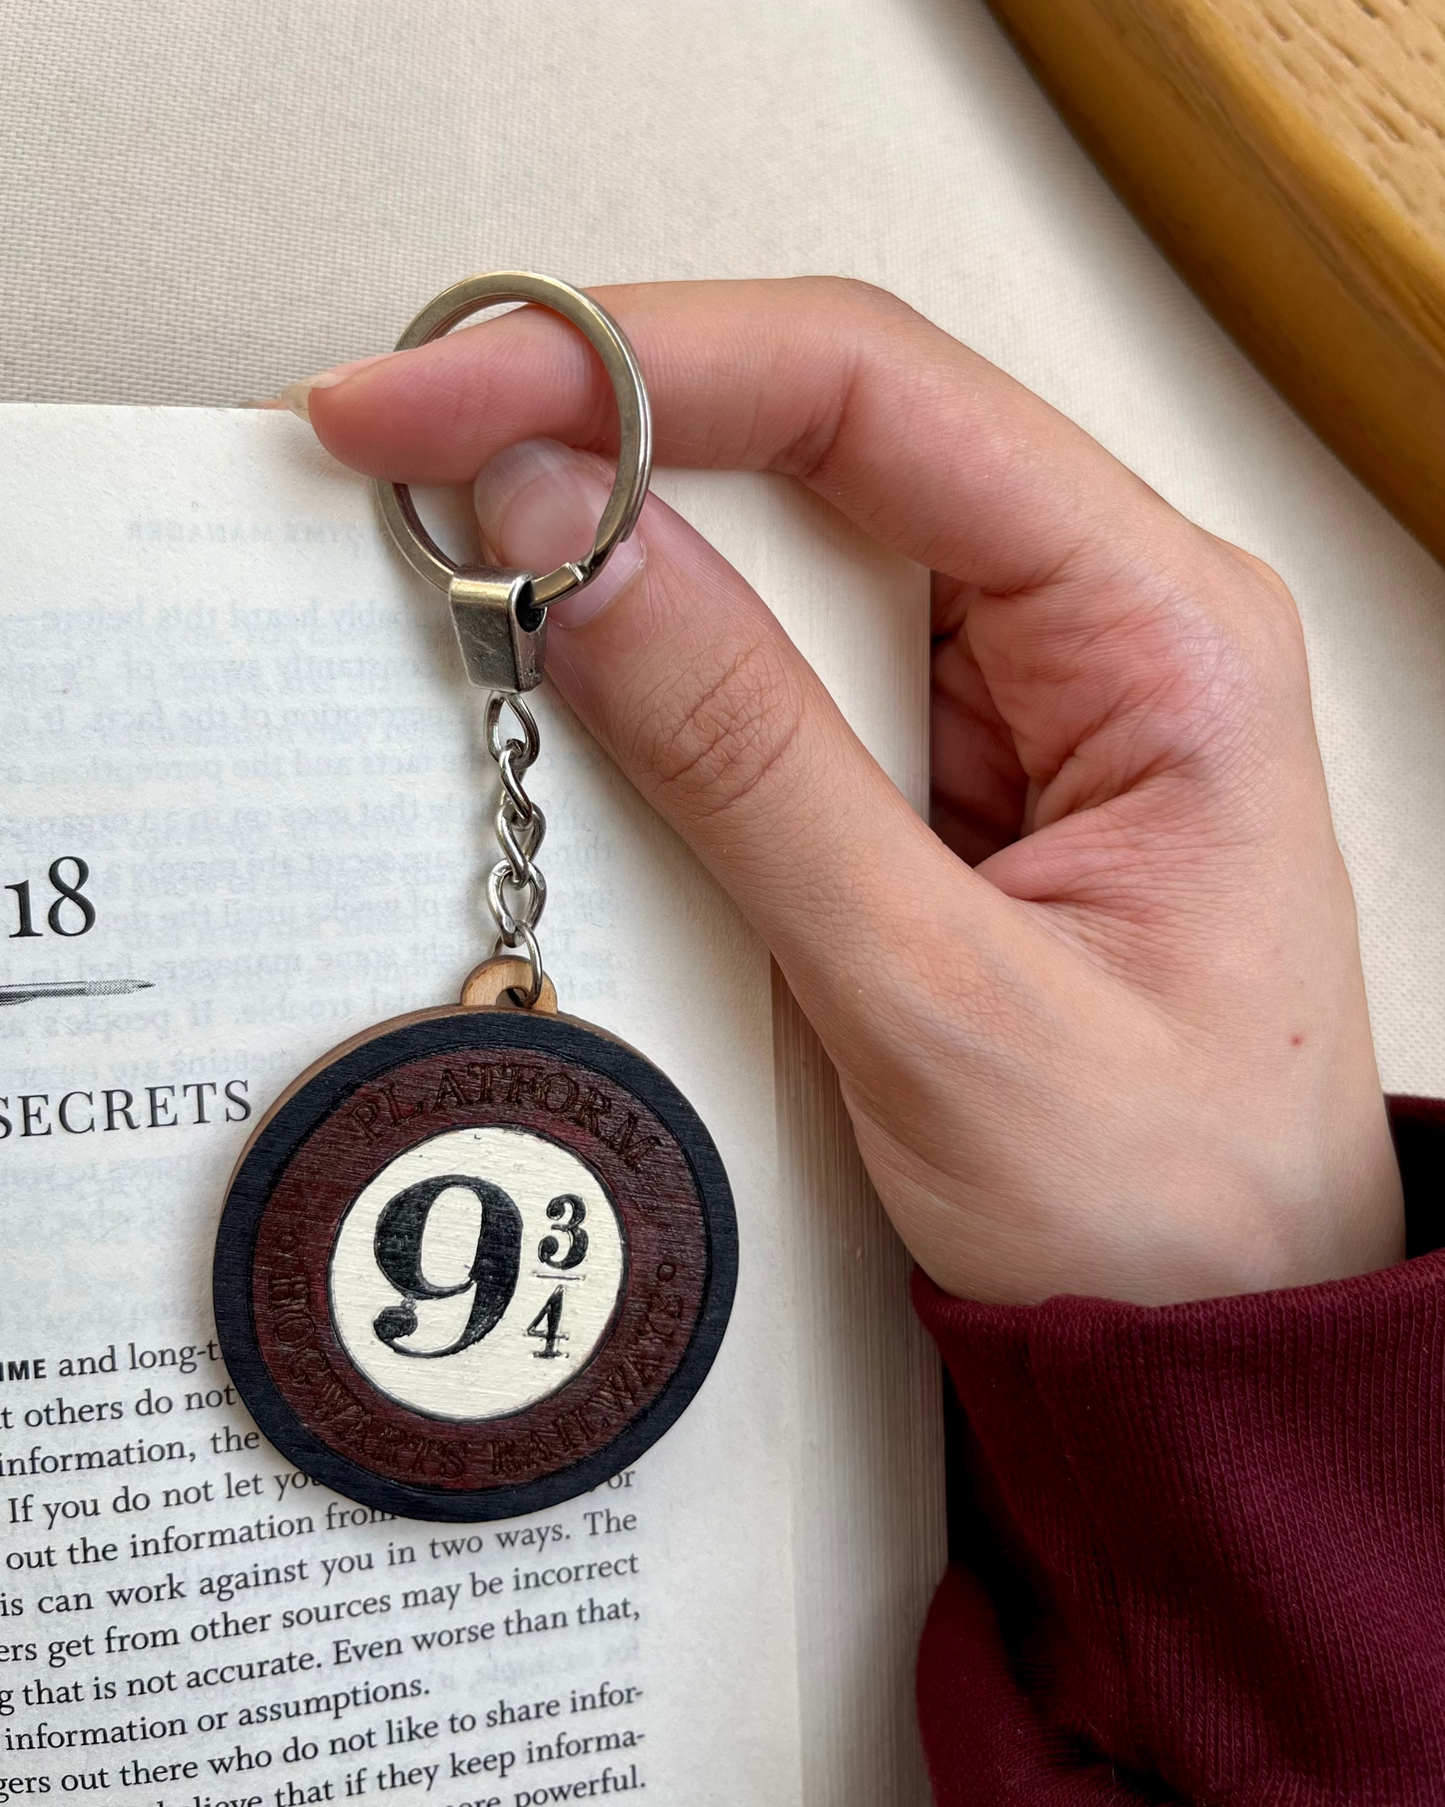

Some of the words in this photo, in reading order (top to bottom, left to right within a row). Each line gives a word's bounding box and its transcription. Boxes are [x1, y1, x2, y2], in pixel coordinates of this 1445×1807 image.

[4, 856, 96, 938] 18
[346, 1061, 664, 1172] PLATFORM
[373, 1174, 525, 1358] 9
[57, 1345, 119, 1378] and
[128, 1340, 224, 1374] long-t
[267, 1271, 466, 1477] HOGWARTS
[490, 1292, 686, 1475] RAILWAYS
[0, 1407, 14, 1430] t
[24, 1397, 124, 1427] others
[135, 1388, 173, 1417] do
[185, 1384, 236, 1412] not
[0, 1439, 196, 1477] information,
[209, 1426, 259, 1454] the
[6, 1545, 58, 1570] out
[66, 1537, 118, 1566] the
[129, 1515, 315, 1559] information
[607, 1470, 636, 1490] or
[8, 1494, 34, 1524] If
[42, 1499, 101, 1531] you
[112, 1485, 150, 1514] do
[162, 1480, 214, 1508] not
[224, 1472, 264, 1499] let
[37, 1593, 95, 1614] can
[105, 1572, 187, 1608] work
[199, 1559, 309, 1603] against
[320, 1553, 374, 1587] you
[388, 1542, 416, 1566] in
[429, 1536, 483, 1559] two
[495, 1524, 570, 1553] ways.
[584, 1508, 637, 1536] The
[20, 1679, 85, 1706] that
[92, 1676, 117, 1701] is
[125, 1670, 178, 1699] not
[186, 1651, 322, 1690] accurate.
[332, 1638, 403, 1666] Even
[410, 1623, 495, 1651] worse
[503, 1609, 569, 1637] than
[576, 1597, 640, 1626] that,
[48, 1634, 95, 1671] get
[104, 1625, 181, 1654] from
[190, 1611, 272, 1643] other
[282, 1595, 391, 1629] sources
[402, 1583, 462, 1611] may
[469, 1572, 503, 1598] be
[513, 1554, 639, 1592] incorrect
[5, 1716, 188, 1752] information
[197, 1712, 229, 1733] or
[237, 1679, 430, 1727] assumptions.
[61, 1768, 111, 1791] out
[118, 1759, 198, 1786] there
[207, 1745, 272, 1776] who
[282, 1736, 319, 1764] do
[328, 1728, 378, 1756] not
[385, 1716, 439, 1746] like
[448, 1713, 477, 1734] to
[486, 1699, 560, 1728] share
[570, 1681, 643, 1714] infor-
[273, 1780, 335, 1807] that
[345, 1767, 367, 1797] if
[376, 1763, 440, 1792] they
[449, 1751, 516, 1779] keep
[526, 1731, 645, 1765] informa-
[514, 1764, 646, 1807] powerful.
